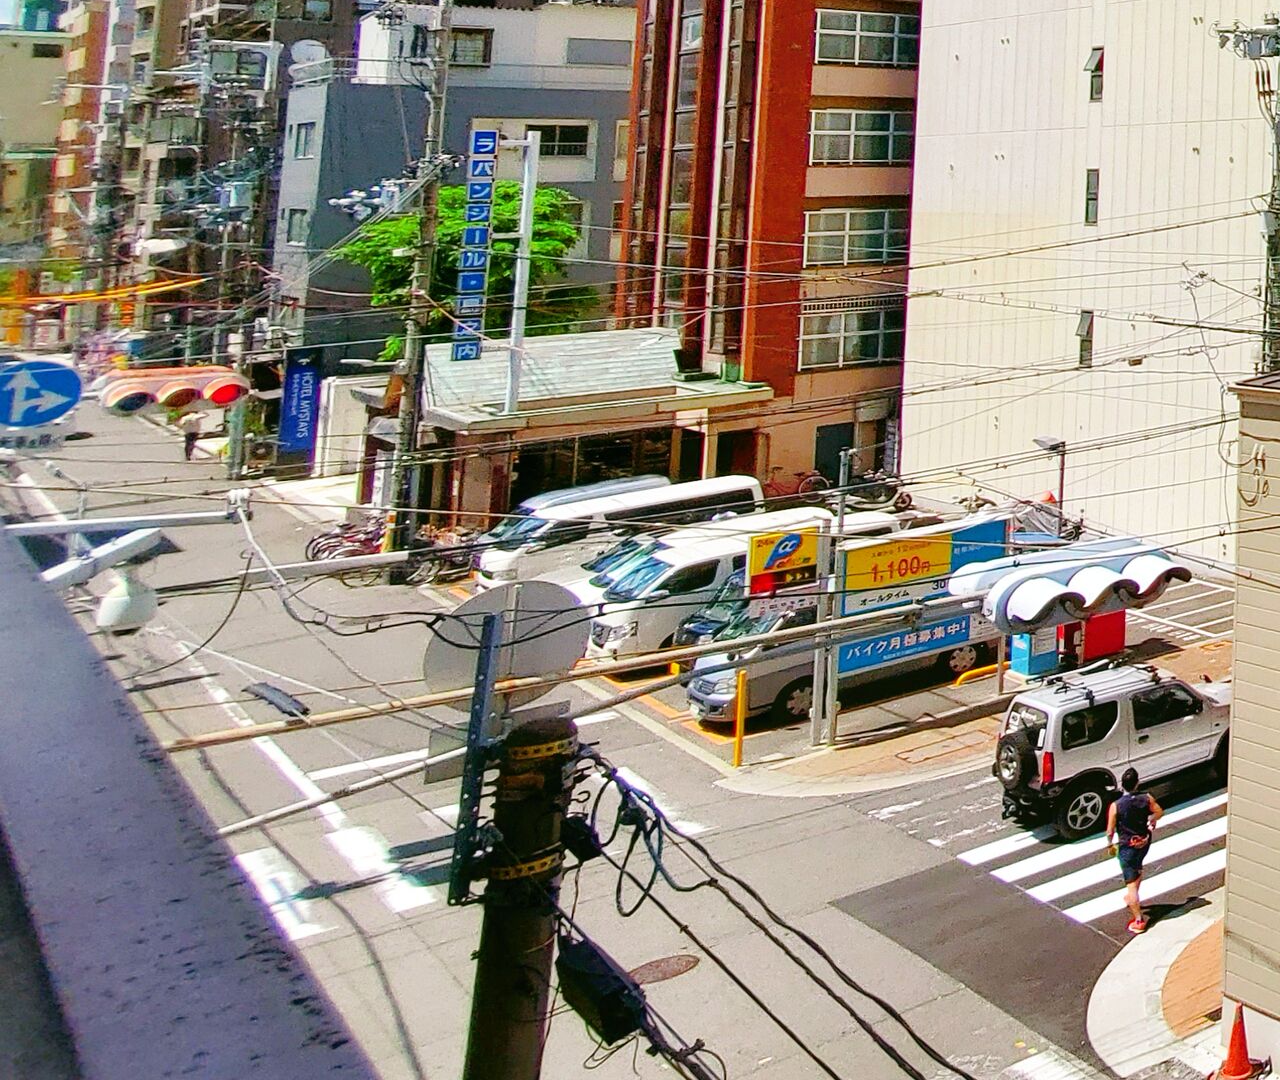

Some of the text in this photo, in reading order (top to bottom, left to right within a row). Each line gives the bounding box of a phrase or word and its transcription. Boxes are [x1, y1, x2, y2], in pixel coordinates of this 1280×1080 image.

[297, 372, 314, 438] HOTEL MYSTAYS
[871, 555, 931, 582] 1,100円
[860, 591, 910, 606] オールタイム
